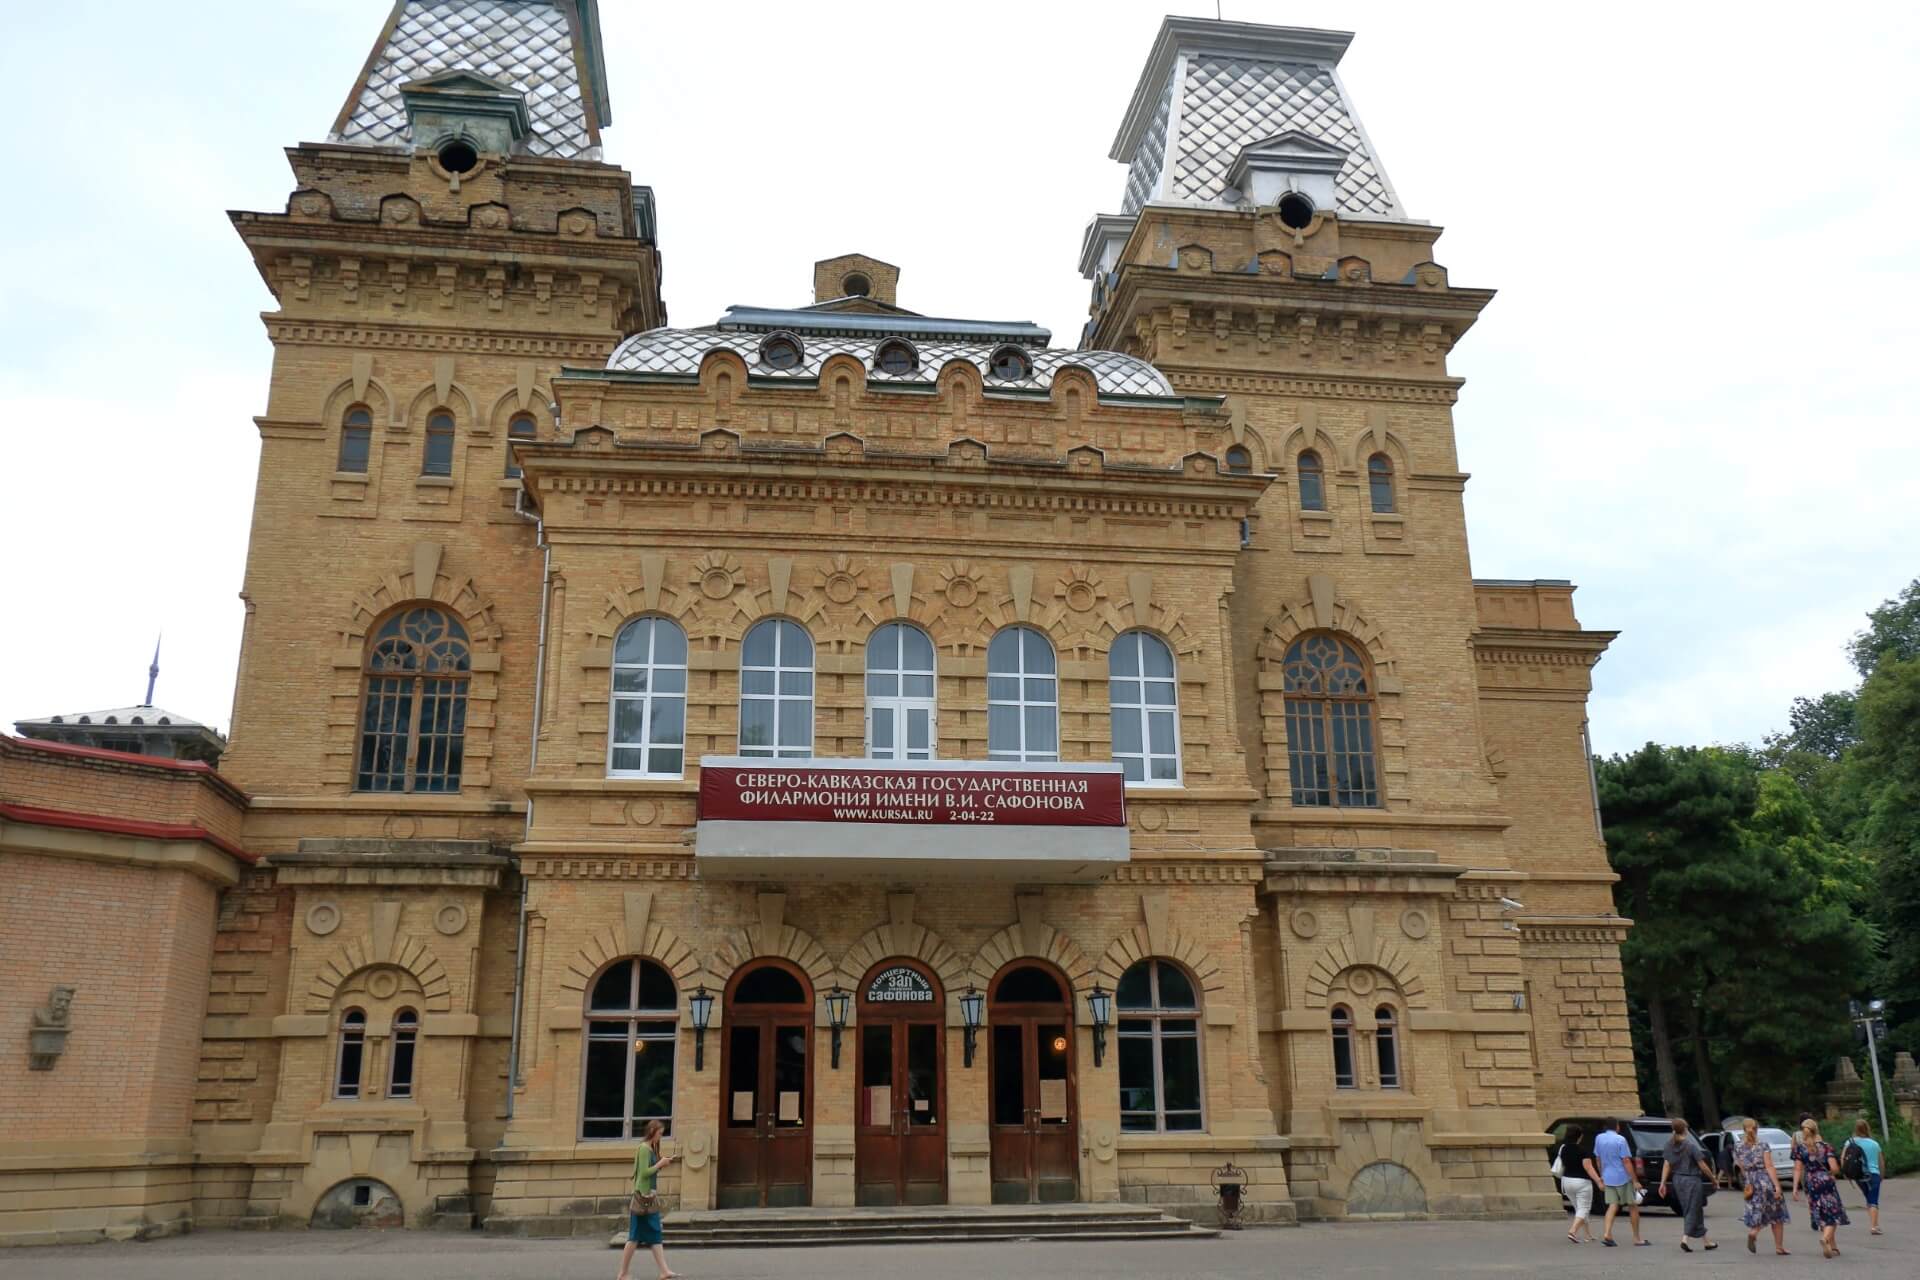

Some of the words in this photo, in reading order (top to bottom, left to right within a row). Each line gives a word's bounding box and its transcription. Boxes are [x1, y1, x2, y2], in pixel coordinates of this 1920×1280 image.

[735, 773, 916, 790] СЕВЕРО-КАВКАЗСКАЯ
[922, 776, 1088, 793] ГОСУДАРСТВЕННАЯ
[739, 790, 870, 806] ФИЛАРМОНИЯ
[876, 793, 939, 807] ИМЕНИ
[945, 794, 979, 807] В.И.
[984, 795, 1085, 810] САФОНОВА
[833, 808, 933, 820] WWW.KURSAL.RU
[949, 810, 994, 821] 2-04-22
